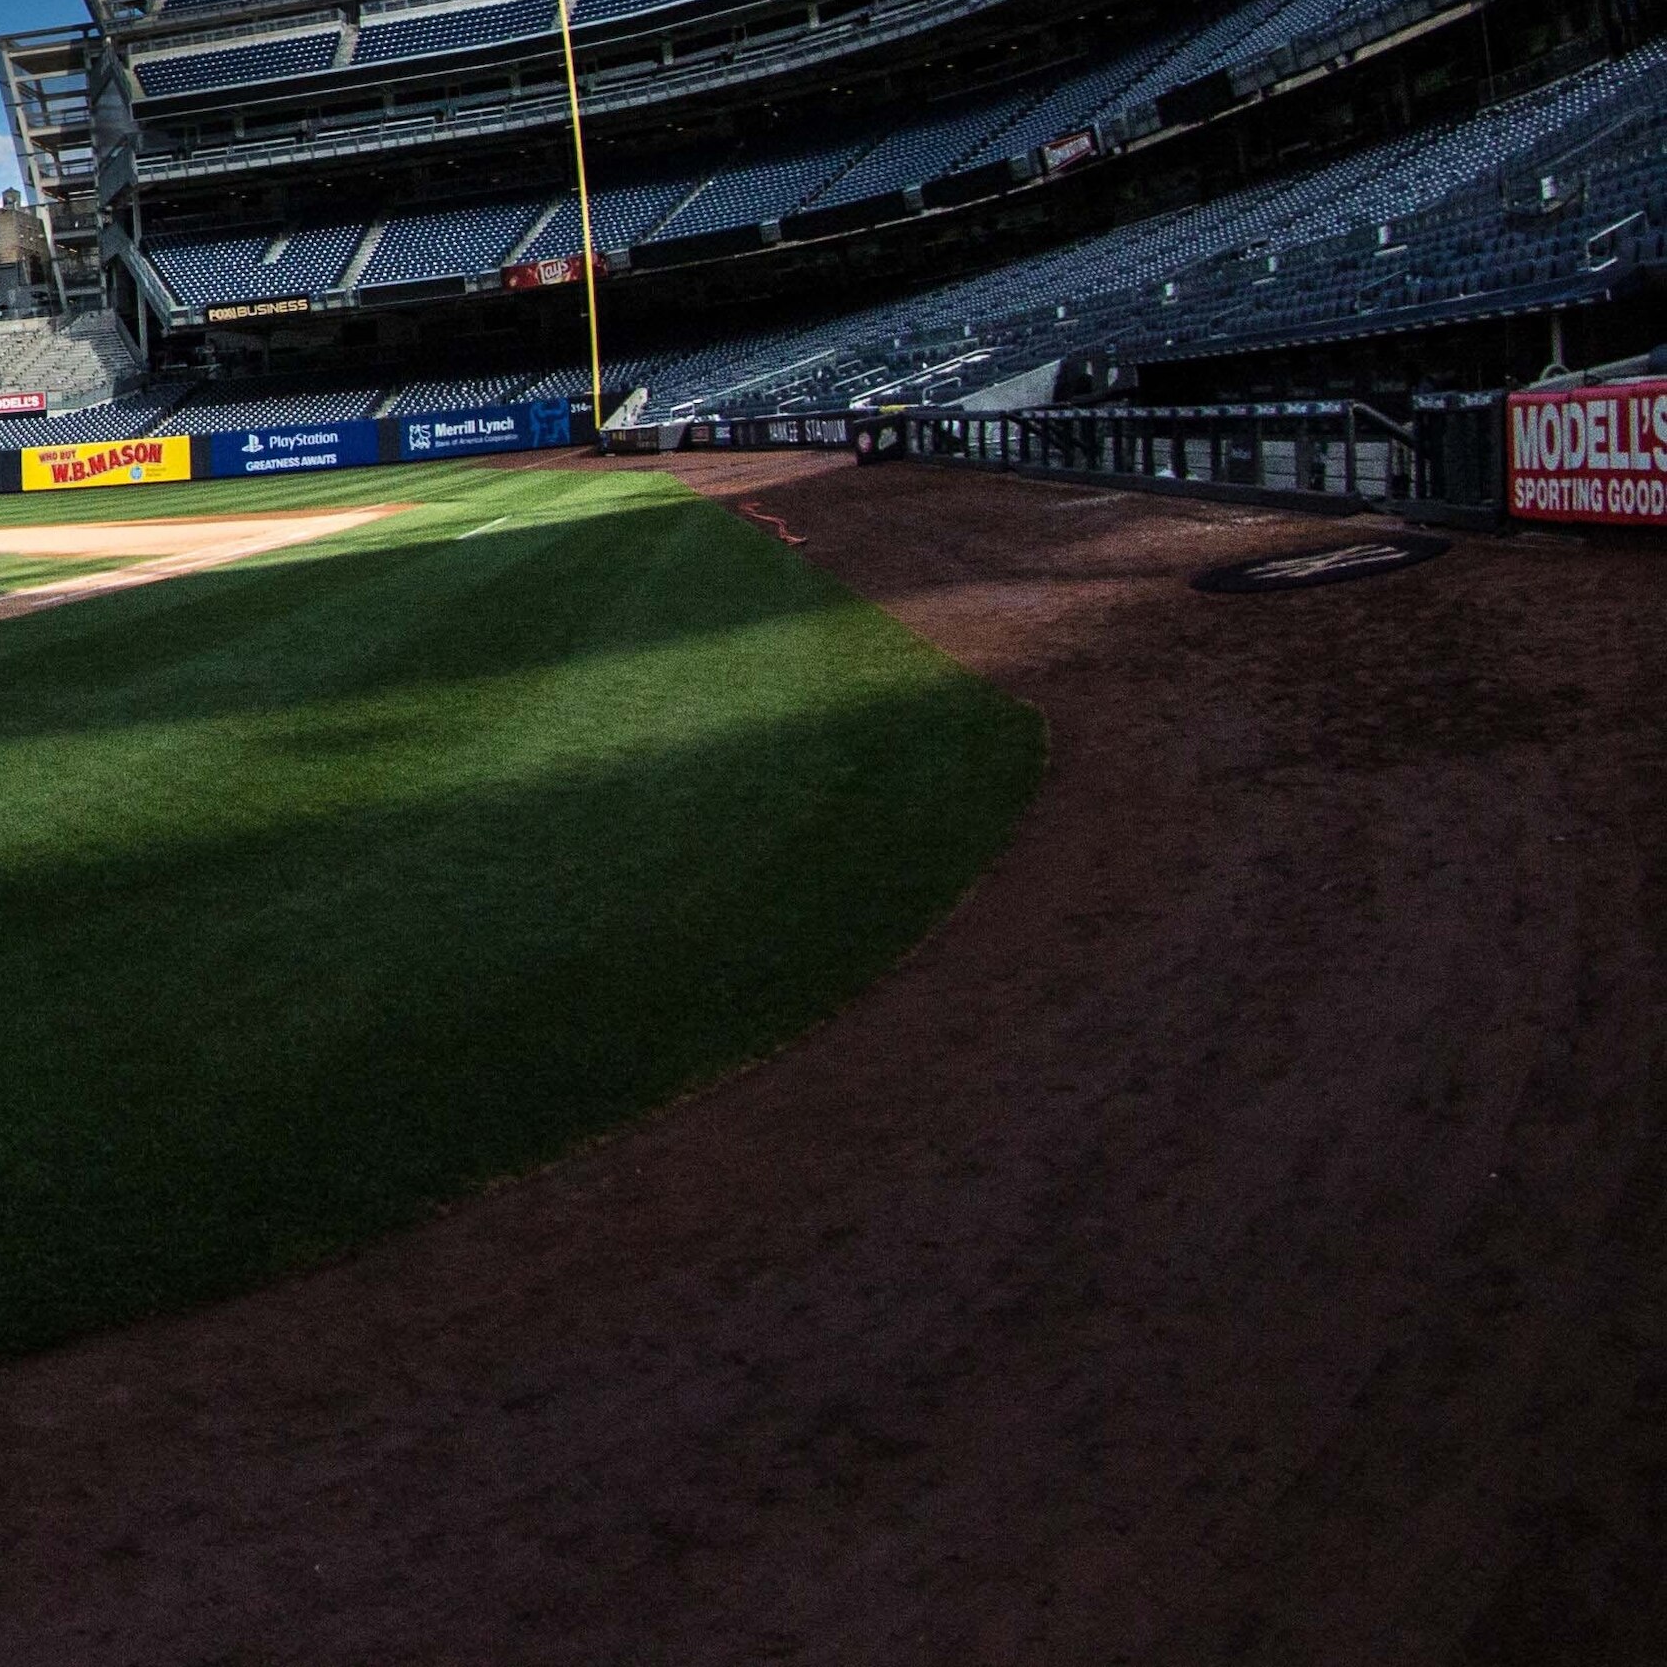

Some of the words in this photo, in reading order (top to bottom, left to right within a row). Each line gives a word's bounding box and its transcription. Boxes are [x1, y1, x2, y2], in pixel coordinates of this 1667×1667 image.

[238, 299, 309, 317] BUSINESS
[435, 420, 475, 437] Merrill
[479, 416, 514, 435] Lynch
[1513, 394, 1667, 471] MODELL'S
[270, 432, 338, 451] PlayStation
[39, 452, 58, 463] WHO
[246, 457, 300, 472] GREATNESS
[301, 453, 337, 466] AWAITS
[1514, 478, 1603, 512] SPORTING
[1608, 478, 1667, 516] GOOD
